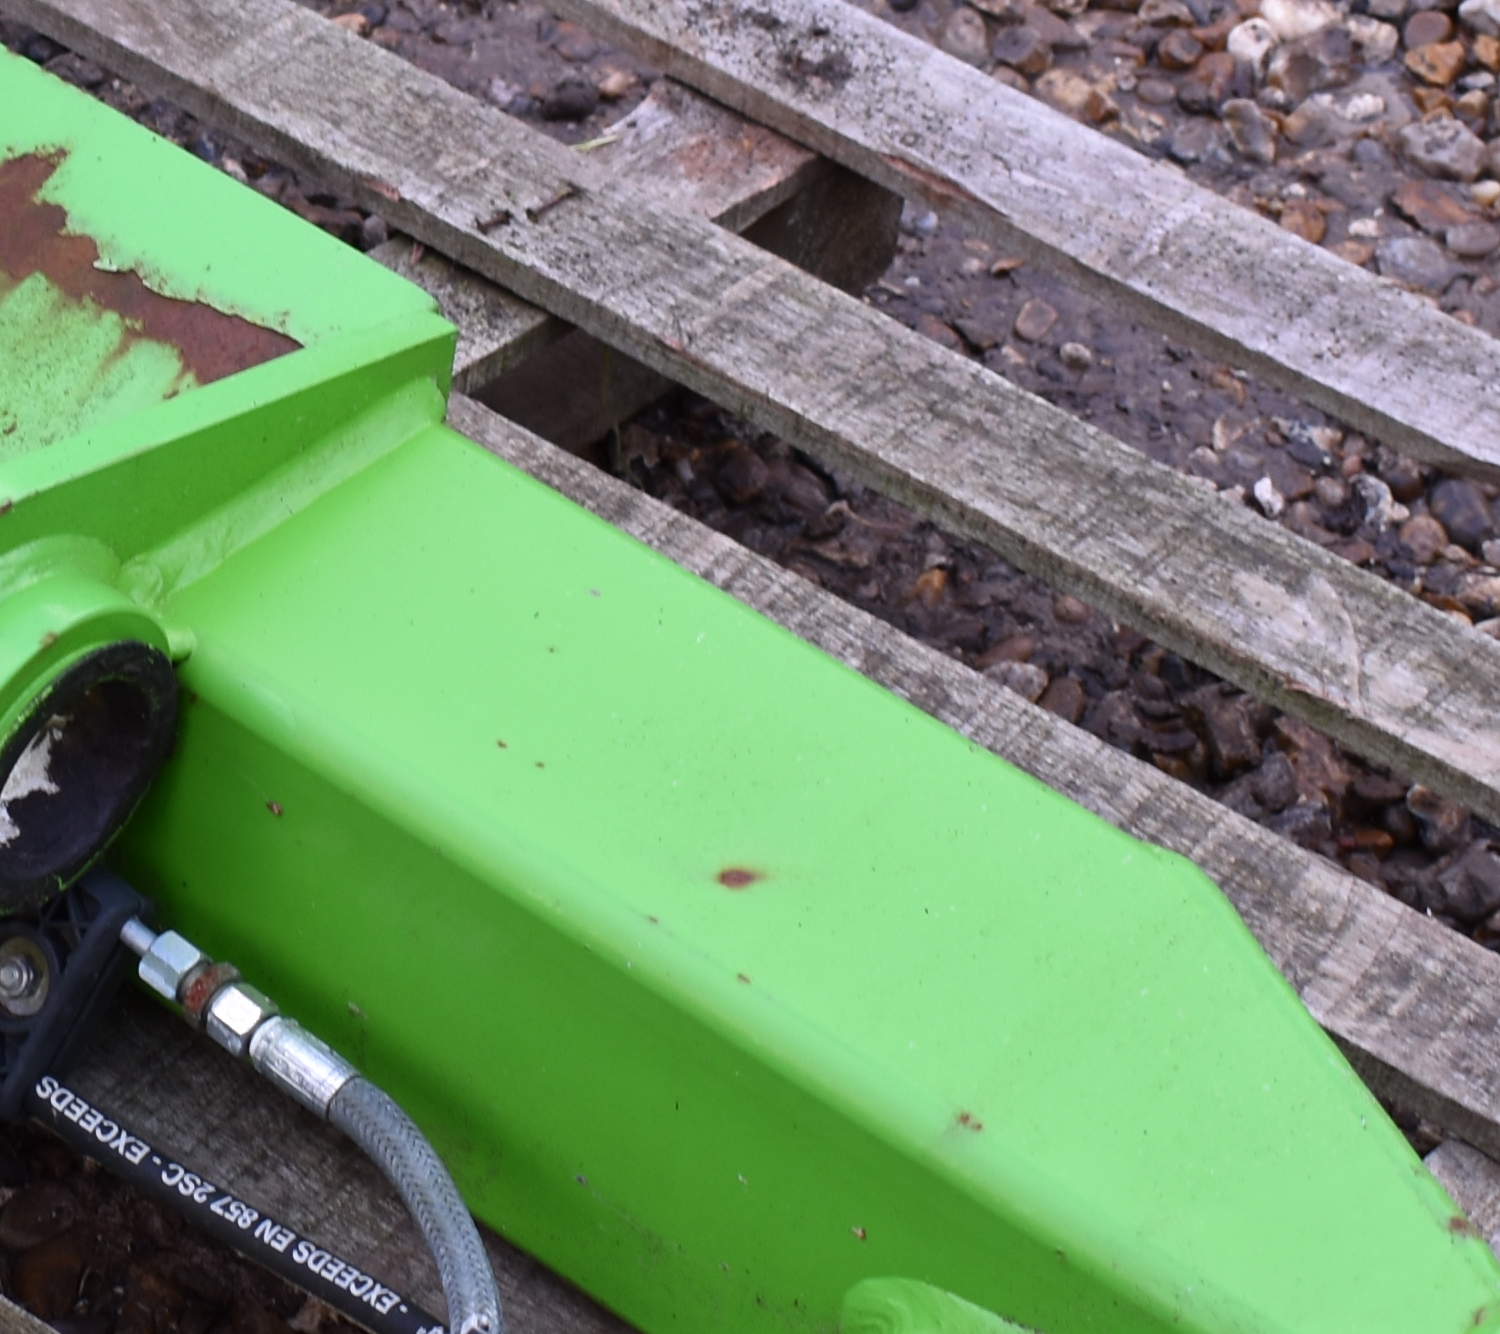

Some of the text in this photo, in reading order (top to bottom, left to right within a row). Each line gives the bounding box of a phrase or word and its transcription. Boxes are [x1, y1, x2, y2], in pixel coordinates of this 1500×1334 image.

[35, 1075, 151, 1165] EXCEEDS
[161, 1163, 216, 1204] 2SC
[209, 1195, 259, 1230] 857
[254, 1218, 297, 1253] EN
[292, 1241, 401, 1315] EXCEEDS
